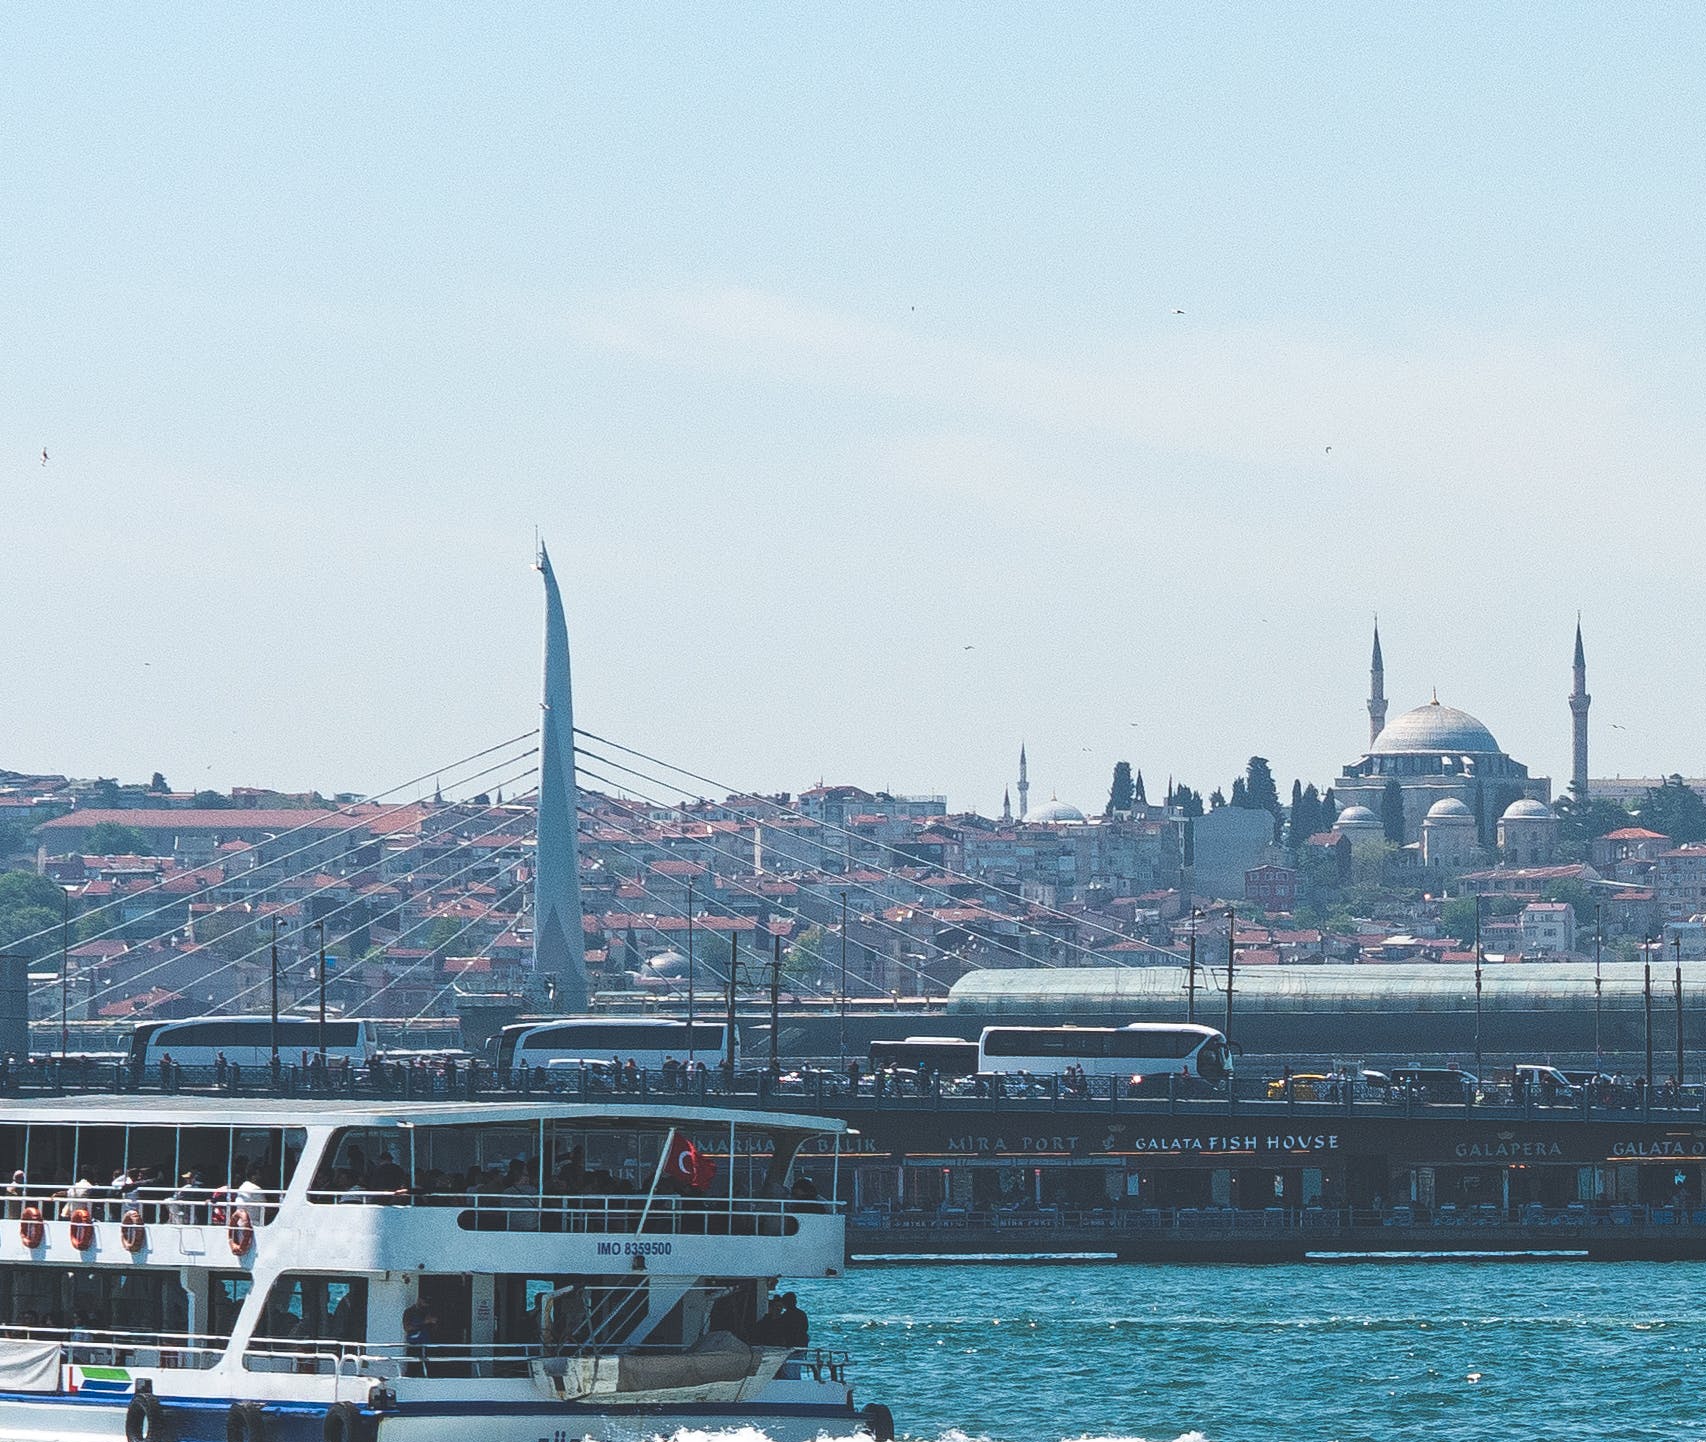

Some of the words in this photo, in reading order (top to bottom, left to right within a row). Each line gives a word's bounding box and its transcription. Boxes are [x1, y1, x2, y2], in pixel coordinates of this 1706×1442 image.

[817, 1138, 876, 1152] BALIK
[1021, 1136, 1079, 1151] PORT
[1135, 1137, 1203, 1150] GALATA
[1208, 1135, 1257, 1150] FISH
[1266, 1134, 1339, 1150] HOUSE
[1455, 1141, 1562, 1157] GALAPERA
[1612, 1140, 1685, 1156] GALATA
[597, 1242, 621, 1255] IMO
[624, 1242, 672, 1255] 8359500
